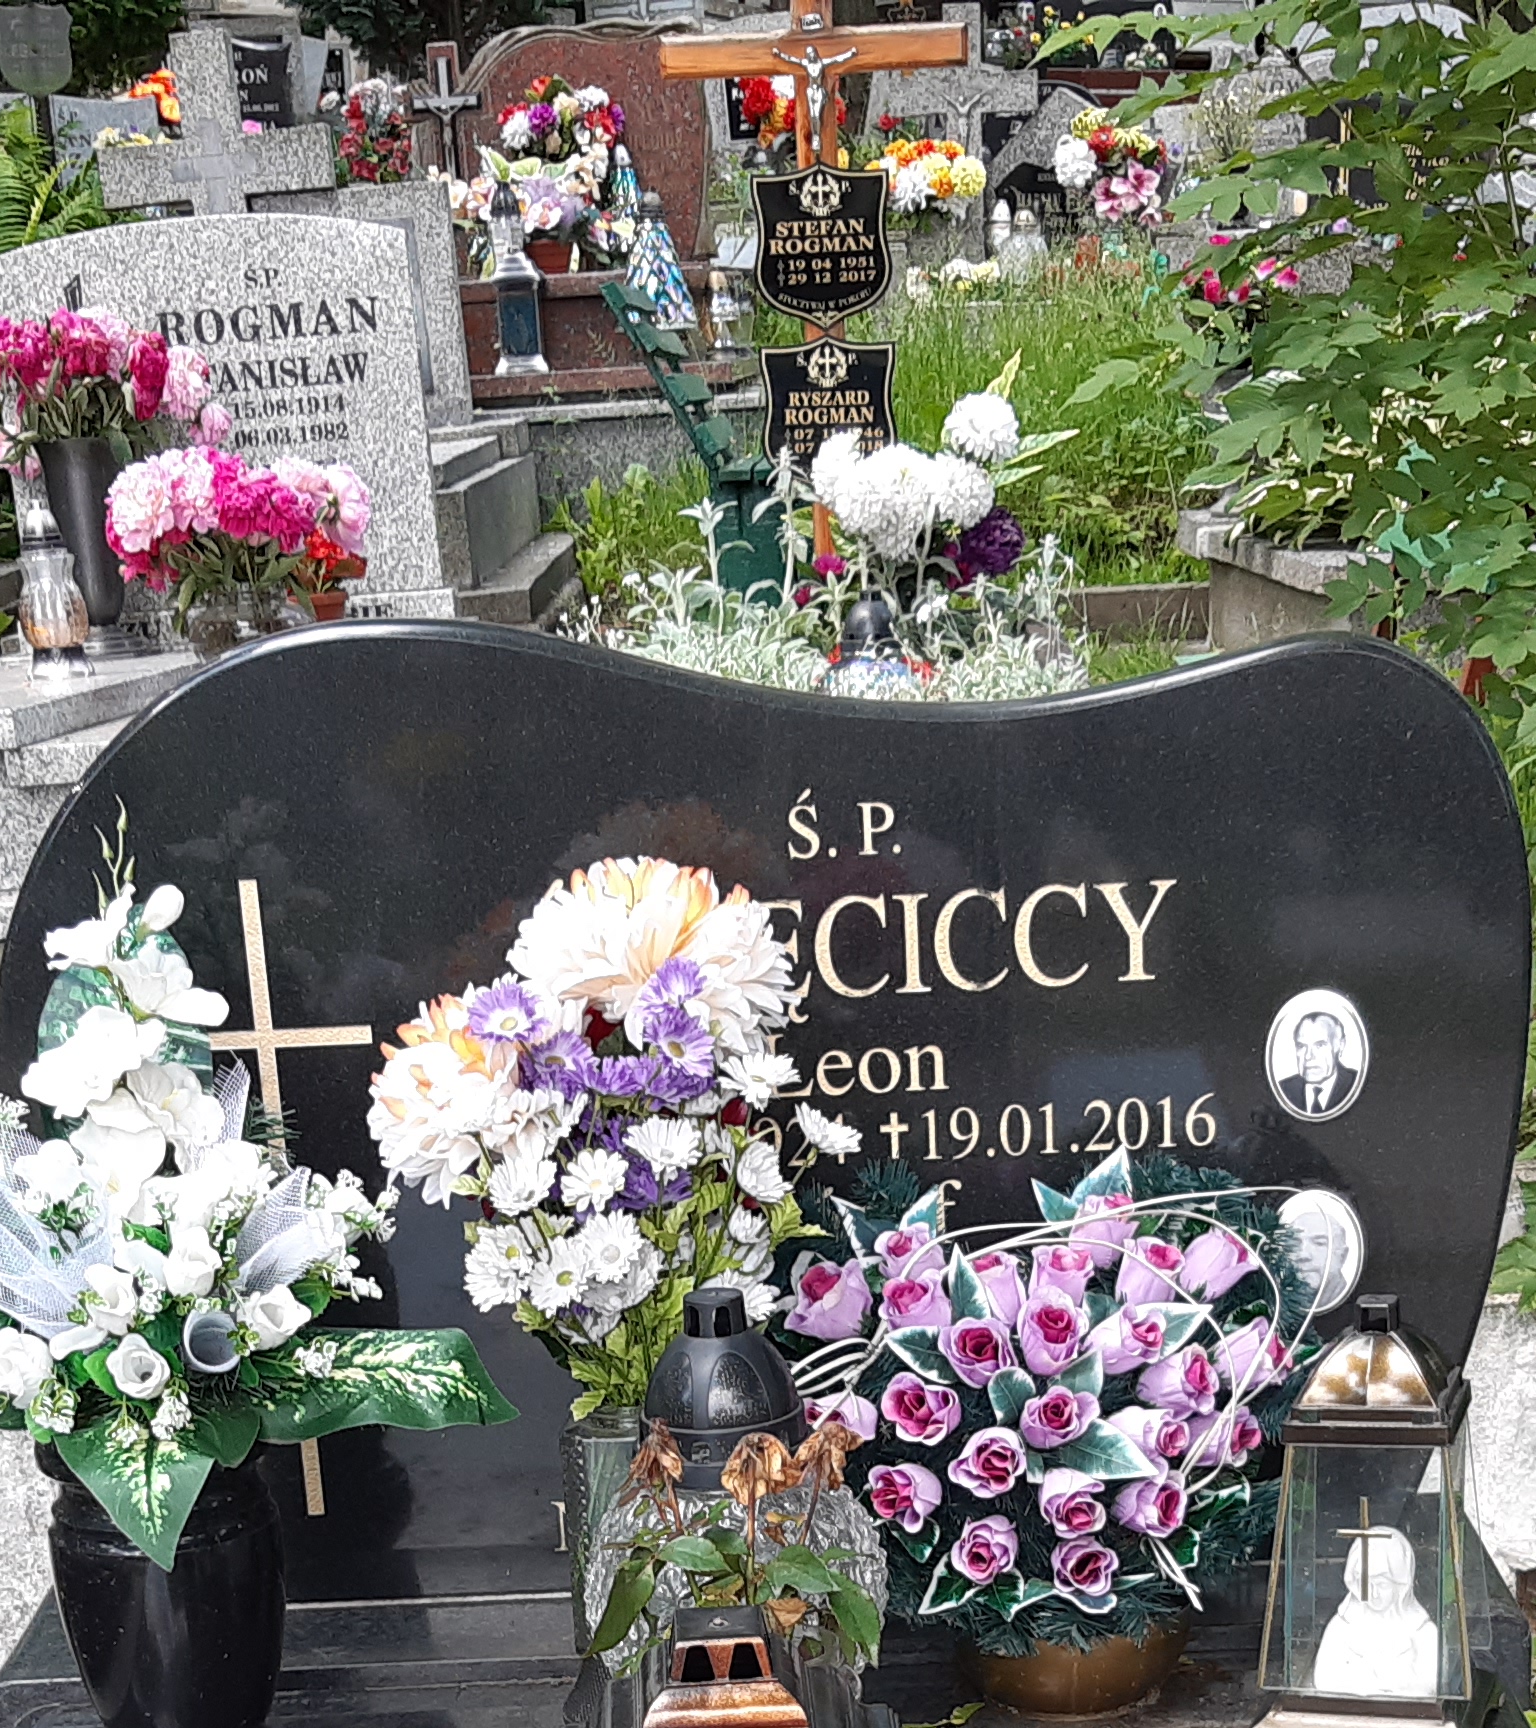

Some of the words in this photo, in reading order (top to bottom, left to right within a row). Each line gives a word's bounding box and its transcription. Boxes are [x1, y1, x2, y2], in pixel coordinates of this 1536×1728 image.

[775, 218, 865, 237] STEFAN
[768, 234, 876, 255] ROGMAN
[787, 259, 806, 271] 19
[811, 258, 832, 270] 04
[787, 273, 807, 285] 29
[814, 271, 832, 284] 12
[838, 270, 876, 282] 2017
[155, 296, 379, 346] ROGMAN
[788, 389, 870, 407] RYSZARD
[784, 405, 875, 426] ROGMAN
[793, 429, 814, 440] 07
[794, 442, 815, 454] 07
[787, 787, 837, 861] Ś.
[856, 801, 903, 857] P.
[920, 1091, 1218, 1162] 19.01.2016
